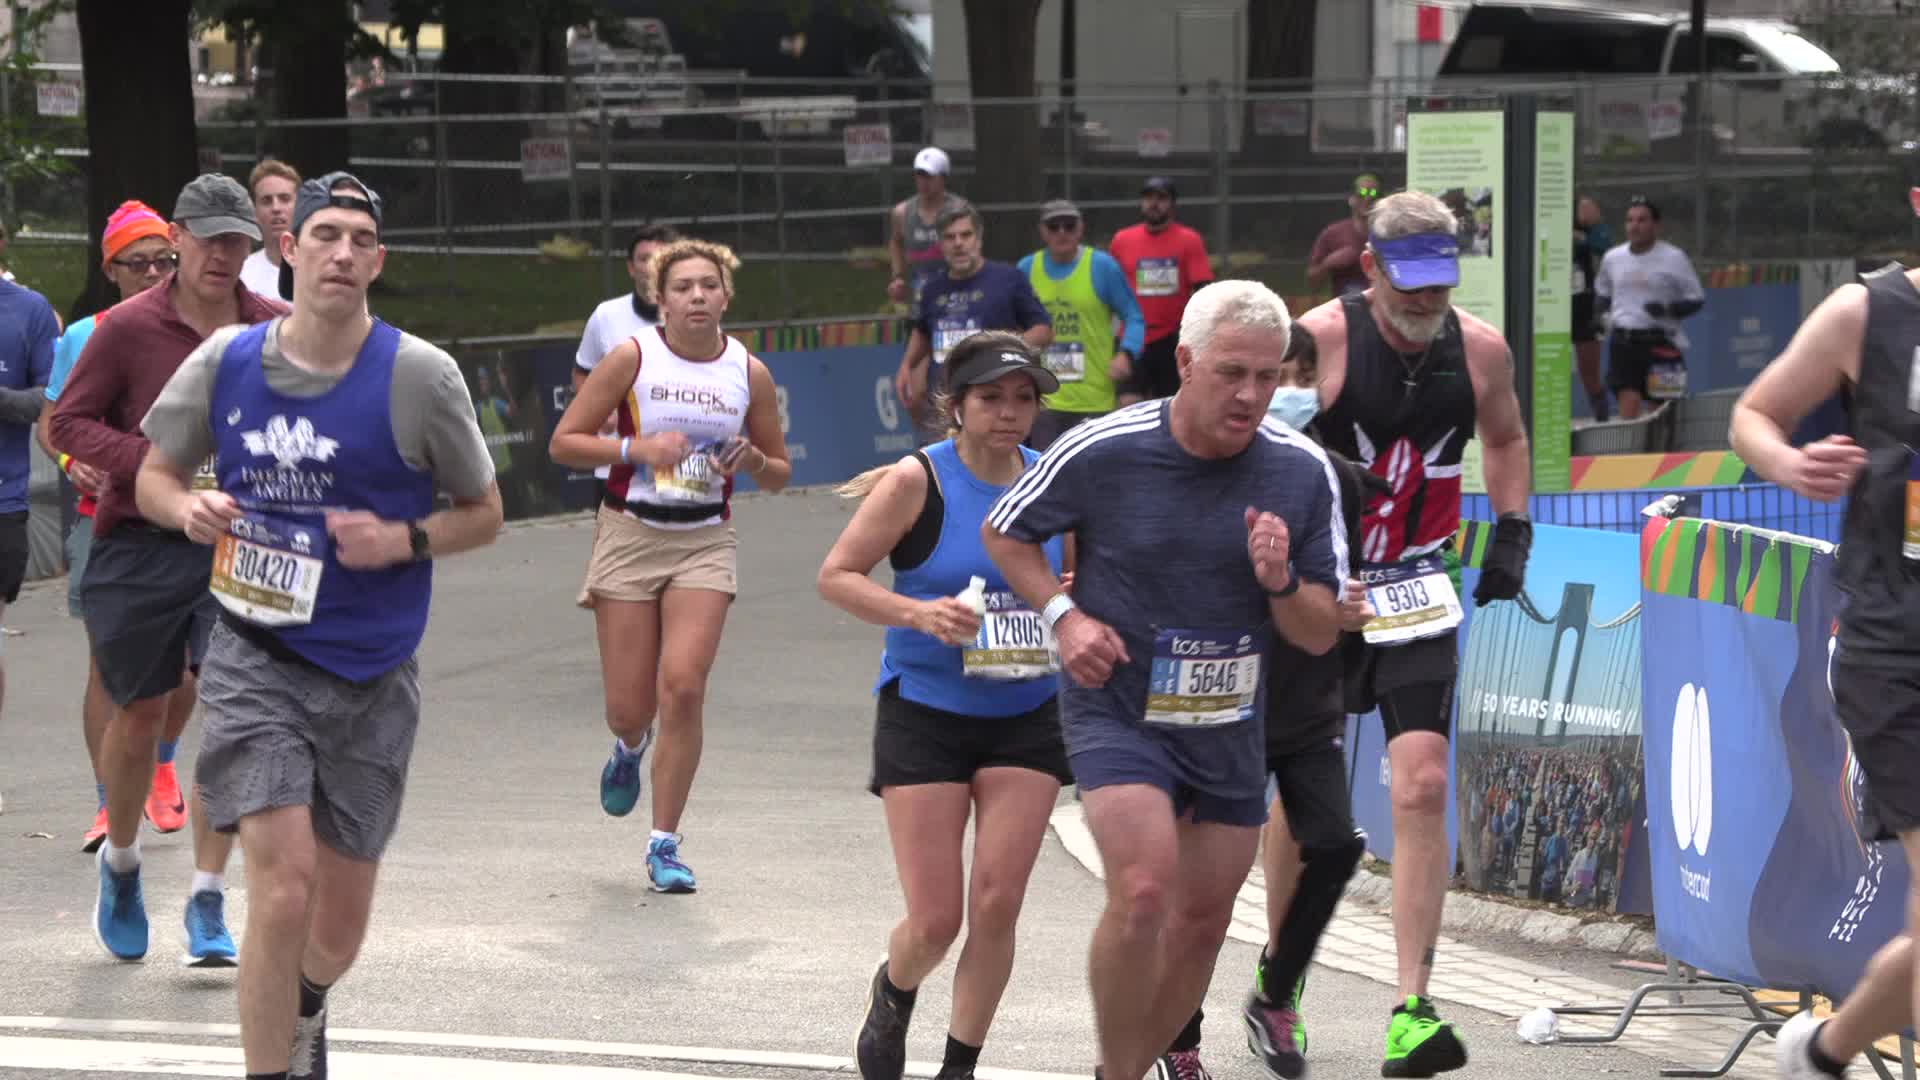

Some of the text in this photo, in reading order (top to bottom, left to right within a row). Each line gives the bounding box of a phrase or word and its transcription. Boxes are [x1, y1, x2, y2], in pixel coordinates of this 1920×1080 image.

[650, 386, 726, 409] SHOCK
[241, 465, 335, 489] IMERMAN
[251, 481, 323, 501] ANGELS
[234, 543, 298, 591] 30420
[1385, 580, 1430, 613] 9313
[993, 614, 1043, 648] 12805
[1171, 635, 1201, 656] tcs
[1189, 662, 1238, 693] 5646
[1482, 693, 1497, 713] 50
[1501, 695, 1548, 719] YEARS
[1552, 701, 1621, 729] RUNNING
